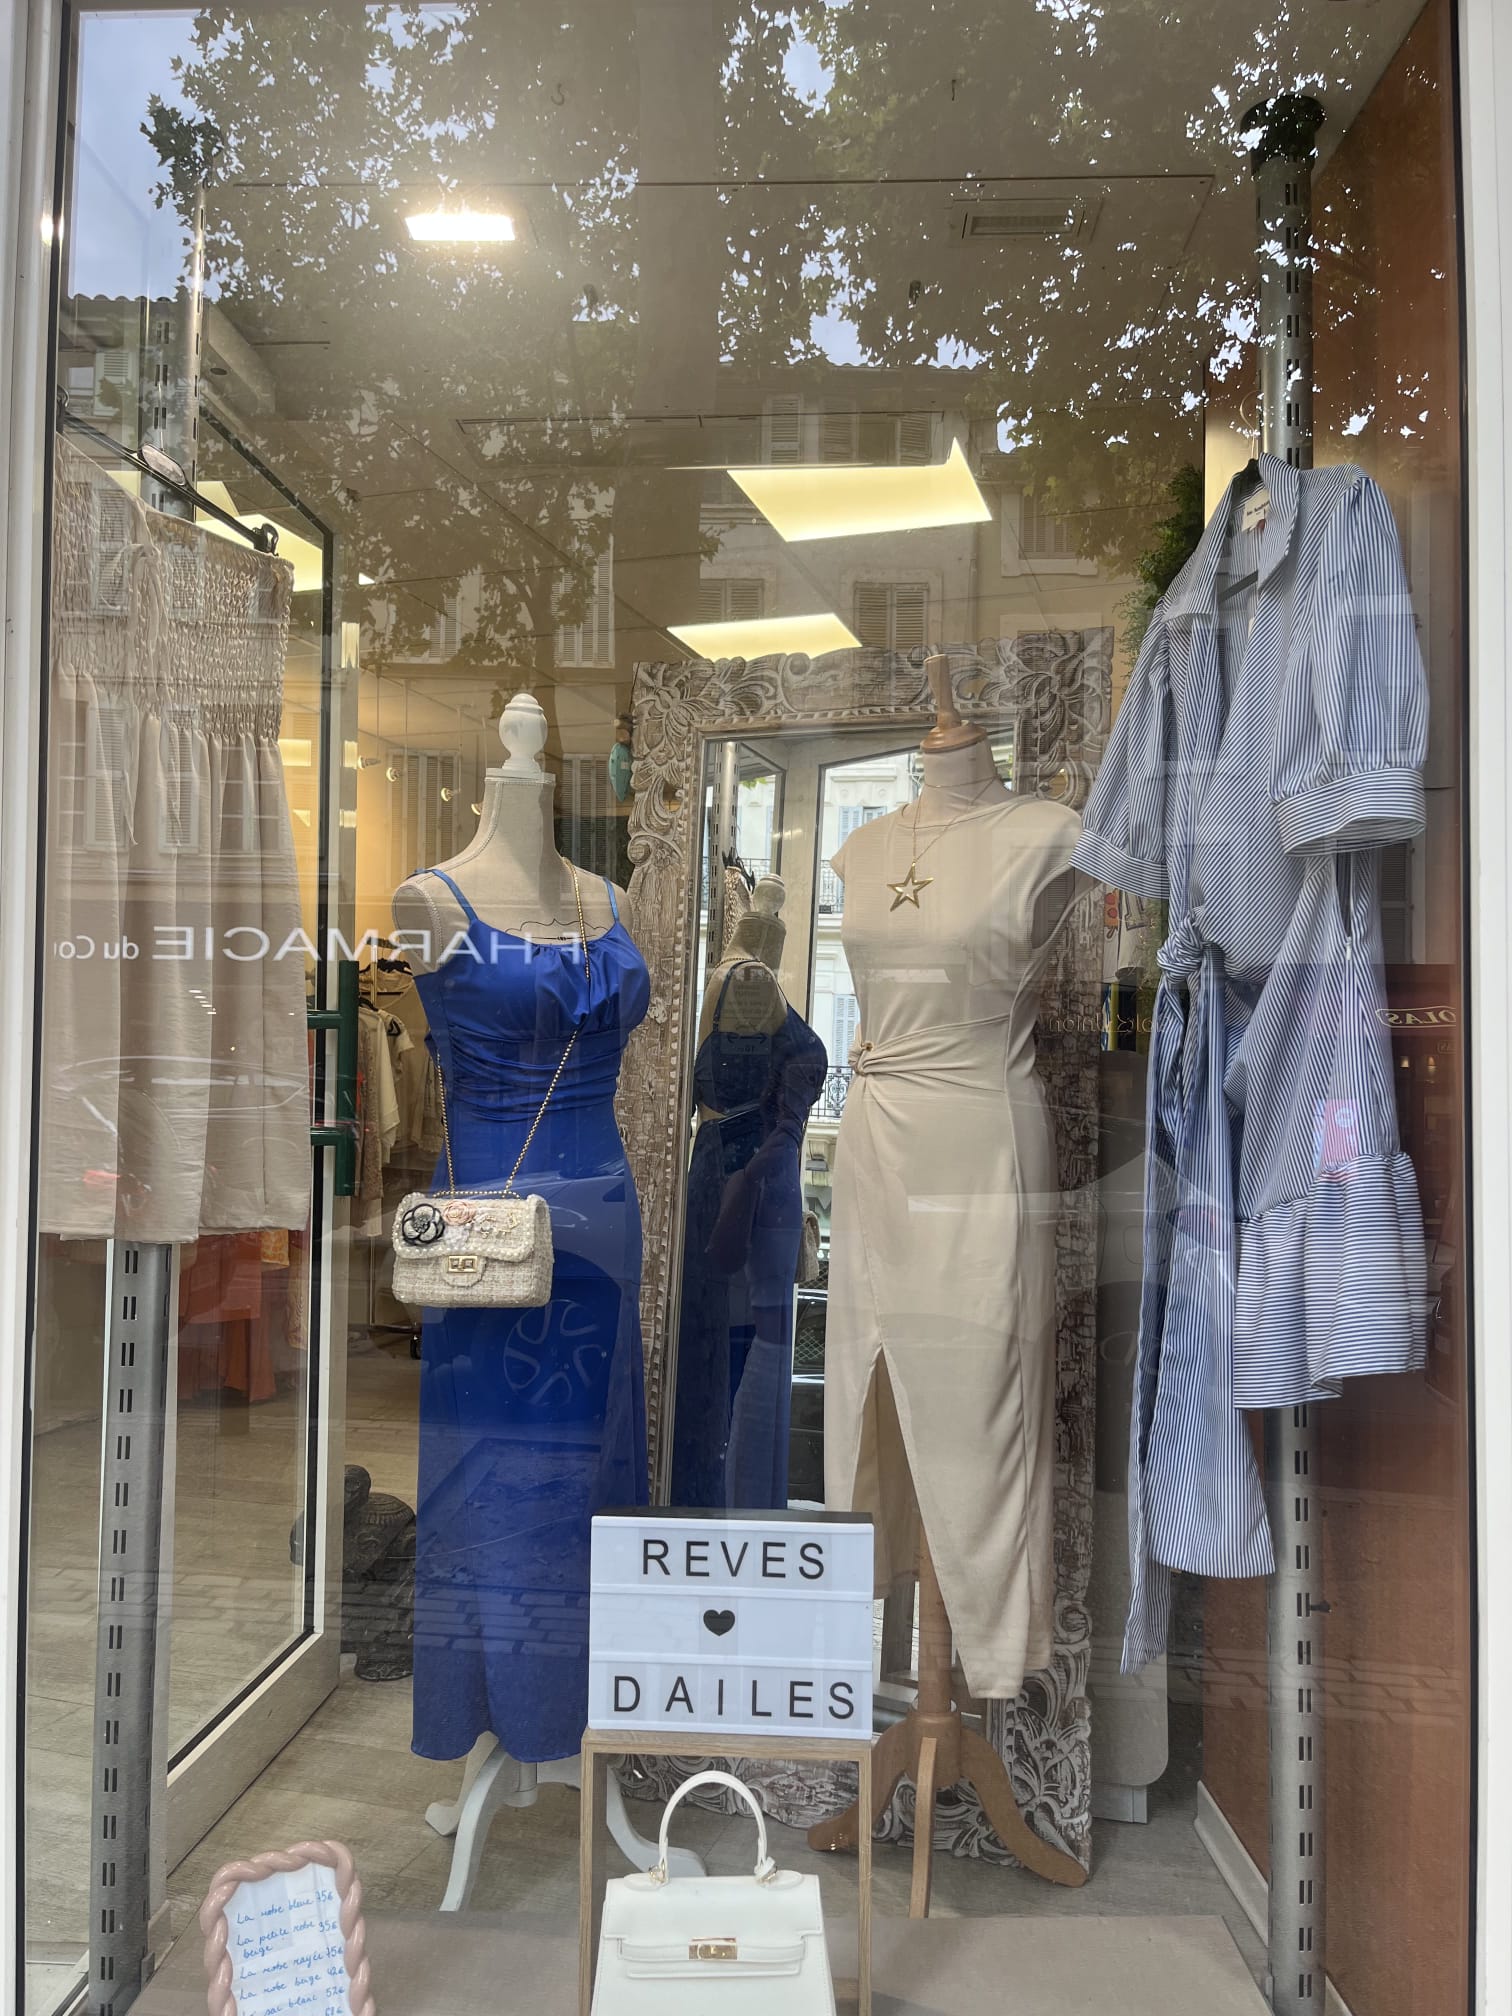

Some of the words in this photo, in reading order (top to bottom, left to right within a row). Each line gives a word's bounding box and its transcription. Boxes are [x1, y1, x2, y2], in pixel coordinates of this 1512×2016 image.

[642, 1539, 825, 1580] REVES
[613, 1675, 855, 1720] DAILES
[237, 1912, 255, 1925] La
[237, 1933, 255, 1946] La
[239, 1967, 257, 1980] La
[239, 1987, 257, 2001] La
